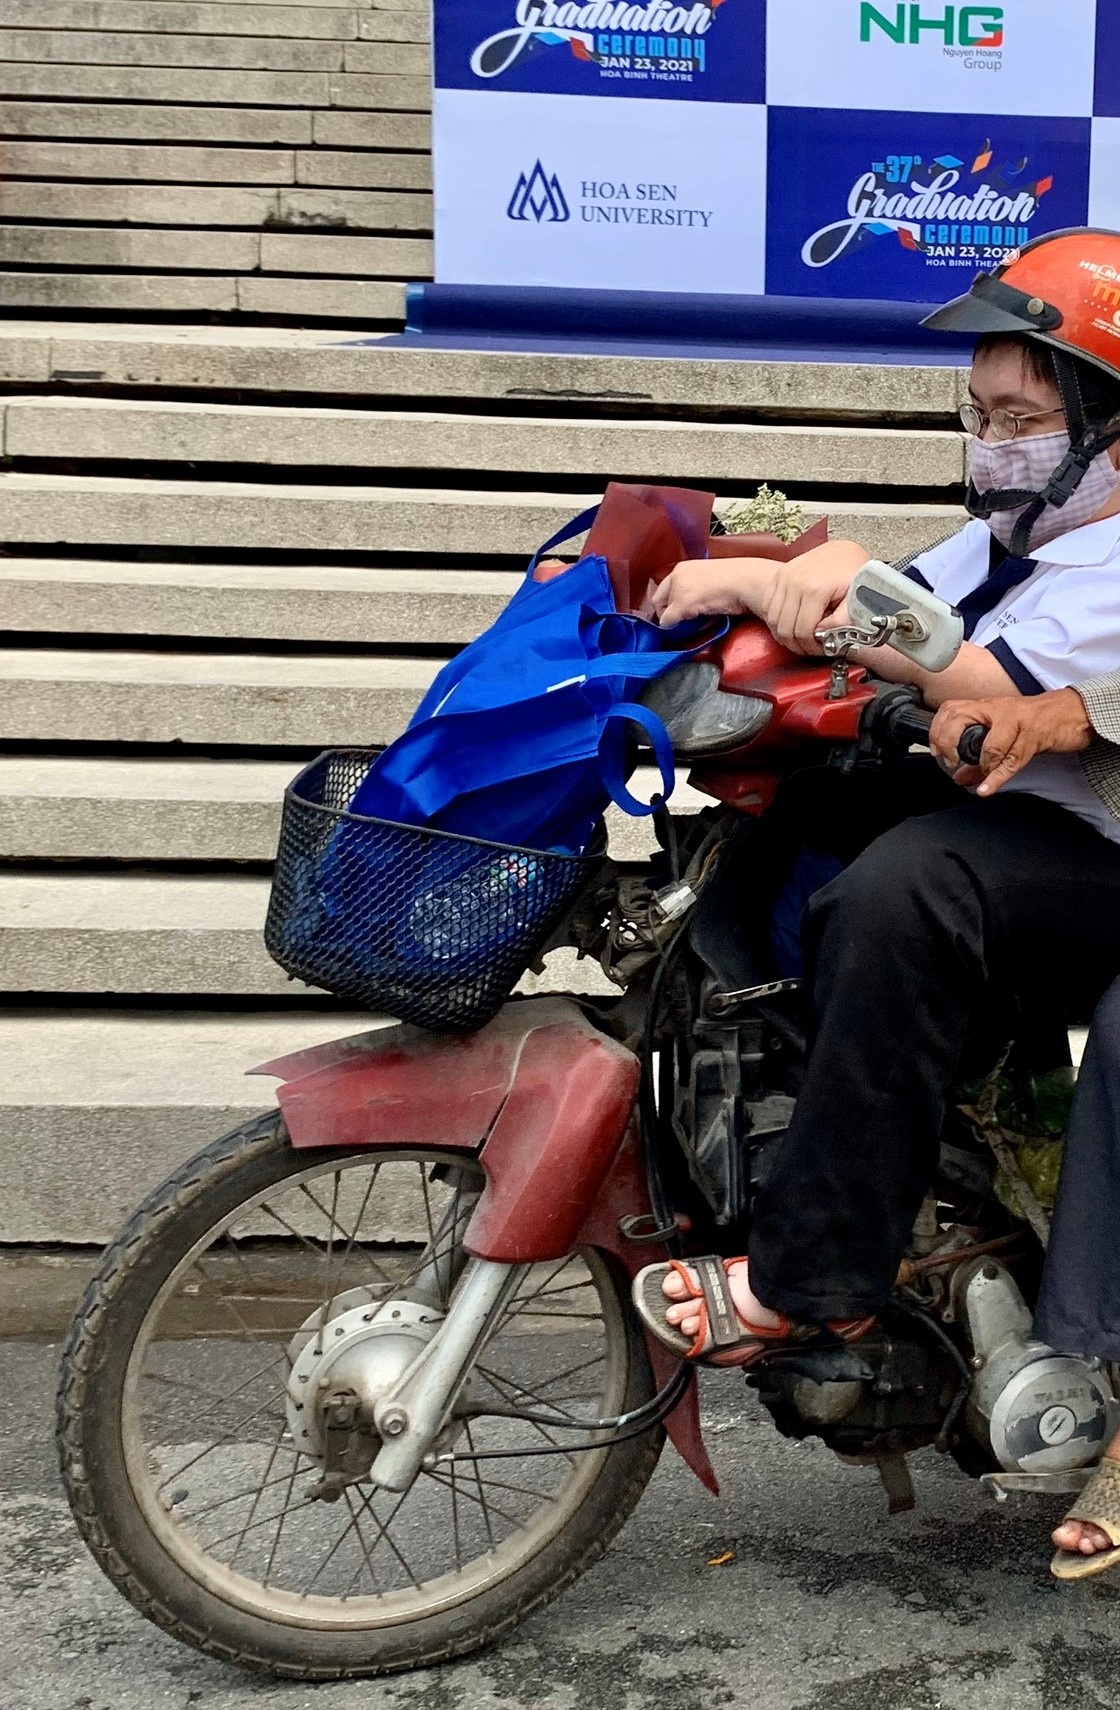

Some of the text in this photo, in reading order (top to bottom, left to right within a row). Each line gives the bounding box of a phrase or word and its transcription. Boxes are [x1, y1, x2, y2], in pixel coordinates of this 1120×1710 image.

[860, 2, 1004, 47] NHG
[470, 0, 712, 78] Graduation
[597, 34, 705, 72] ceremony
[943, 48, 1002, 59] Nguyen Hoang
[600, 56, 693, 72] JAN 23, 2021
[964, 58, 1002, 72] Group
[600, 70, 693, 82] HOA BINH THEATRE
[580, 181, 678, 201] HOA SEN
[580, 205, 714, 228] UNIVERSITY
[801, 170, 1035, 268] Graduation
[926, 246, 955, 257] JAN
[959, 246, 980, 259] 23,
[949, 259, 972, 267] BINH
[975, 260, 998, 268] THEA
